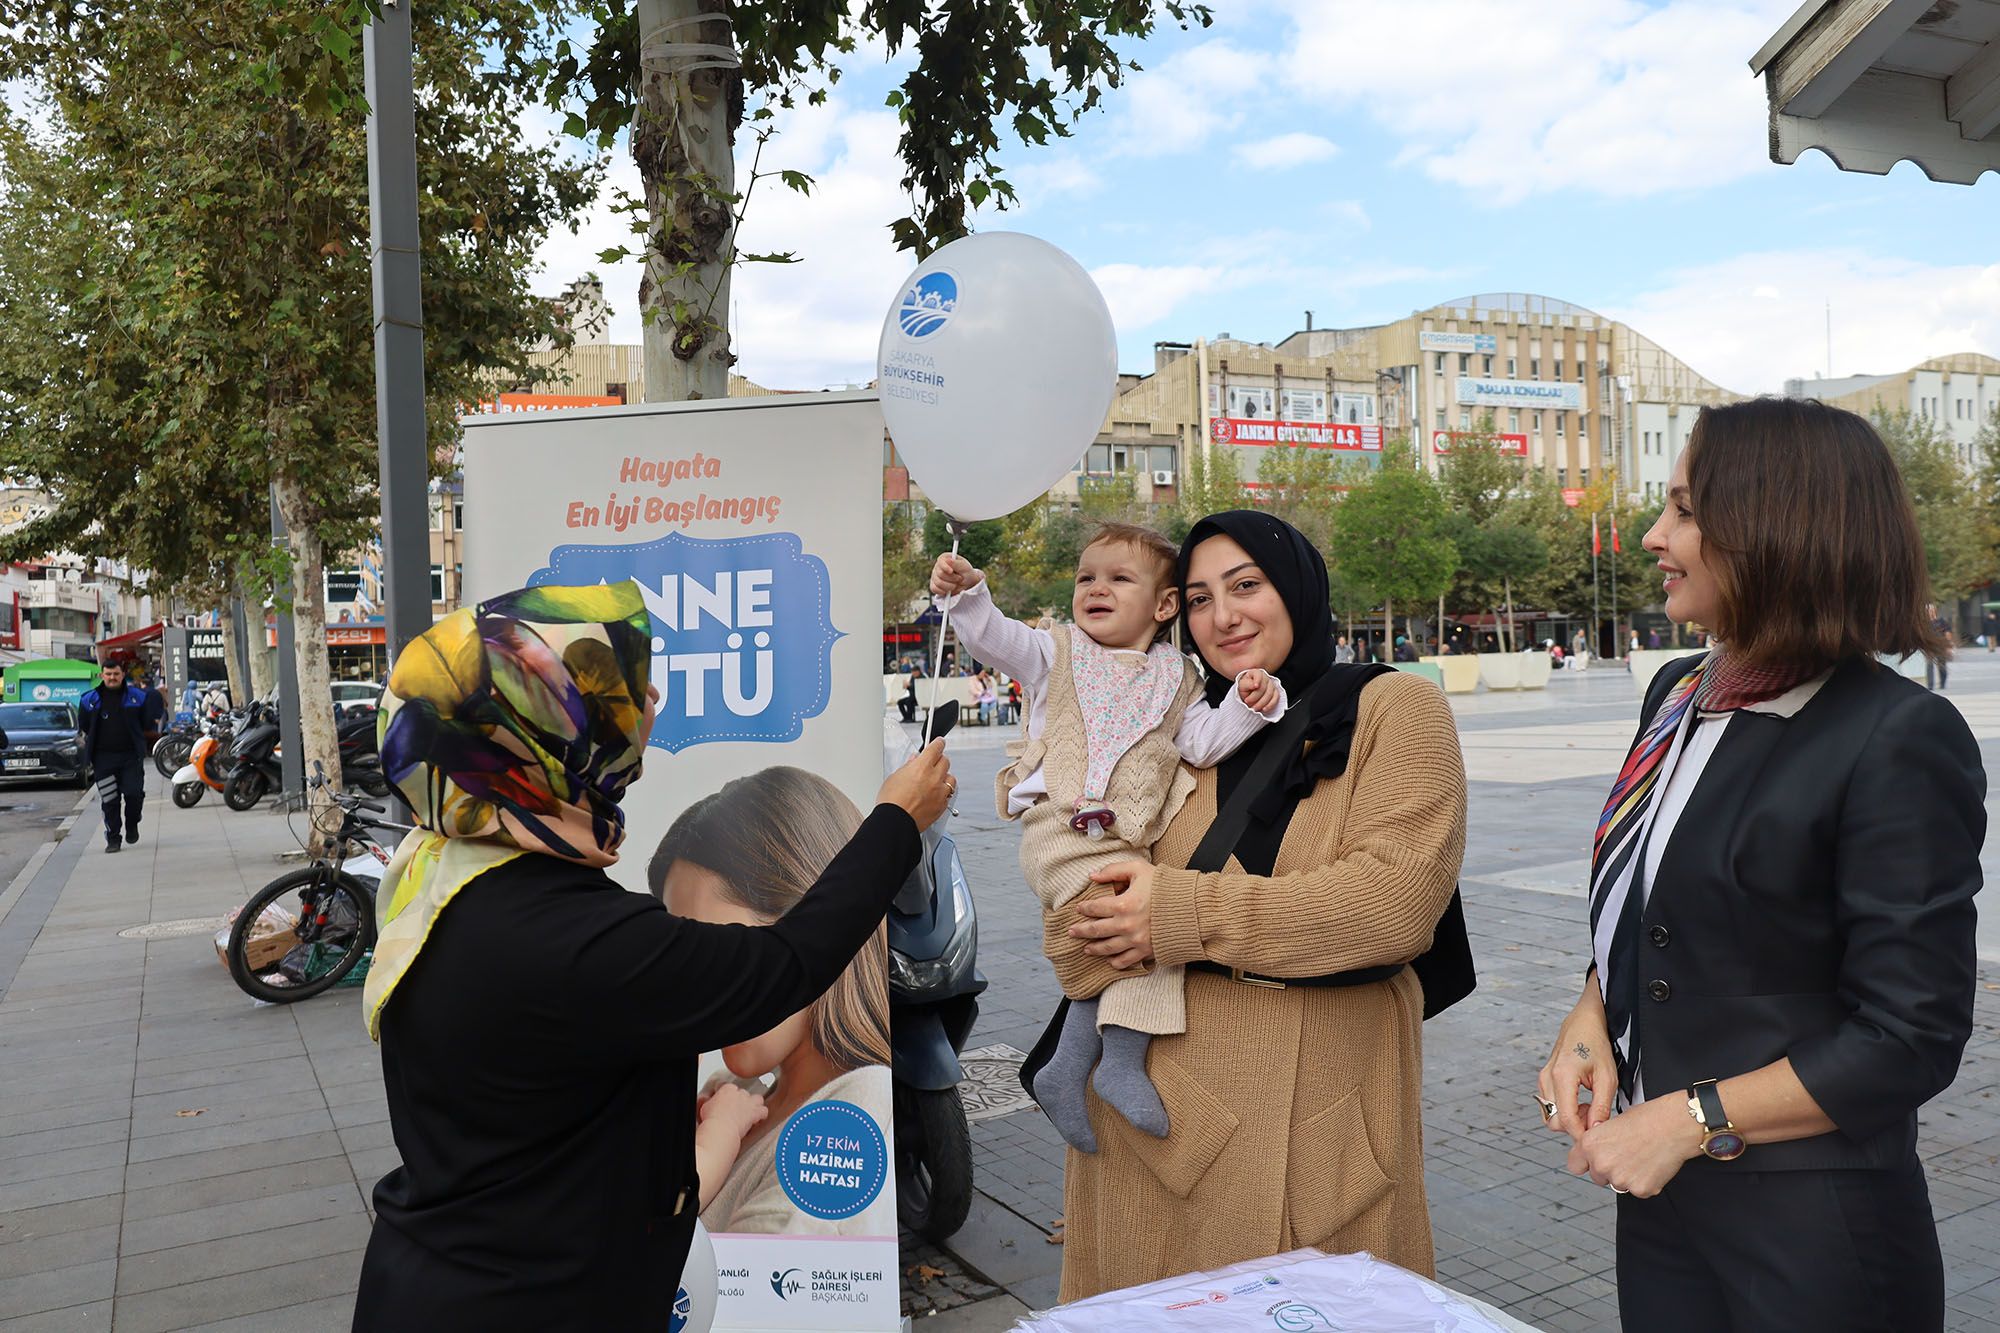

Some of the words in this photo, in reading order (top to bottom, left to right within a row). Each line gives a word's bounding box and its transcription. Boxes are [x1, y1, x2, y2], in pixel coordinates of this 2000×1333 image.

[889, 350, 936, 369] SAKARYA
[884, 363, 945, 388] BÜYÜKŞEHİR
[887, 383, 939, 406] BELEDİYESİ
[1236, 424, 1275, 441] JANEM
[1277, 422, 1335, 444] GÜVENLİK
[619, 452, 721, 488] Hayata
[566, 501, 599, 528] En
[605, 493, 642, 533] İyi
[644, 493, 782, 529] Başlangıç
[598, 569, 774, 633] NNE
[189, 647, 224, 658] EKME
[806, 1134, 823, 1148] 1-7
[827, 1135, 860, 1152] EKİM
[799, 1151, 864, 1171] EMZİRME
[799, 1169, 860, 1189] HAFTASI
[717, 1268, 750, 1278] ANLIĞI
[811, 1269, 848, 1281] SAĞLIK
[850, 1269, 882, 1282] İŞLERİ
[811, 1280, 851, 1292] DAİRESİ
[811, 1291, 869, 1303] BAŞKANLIĞI
